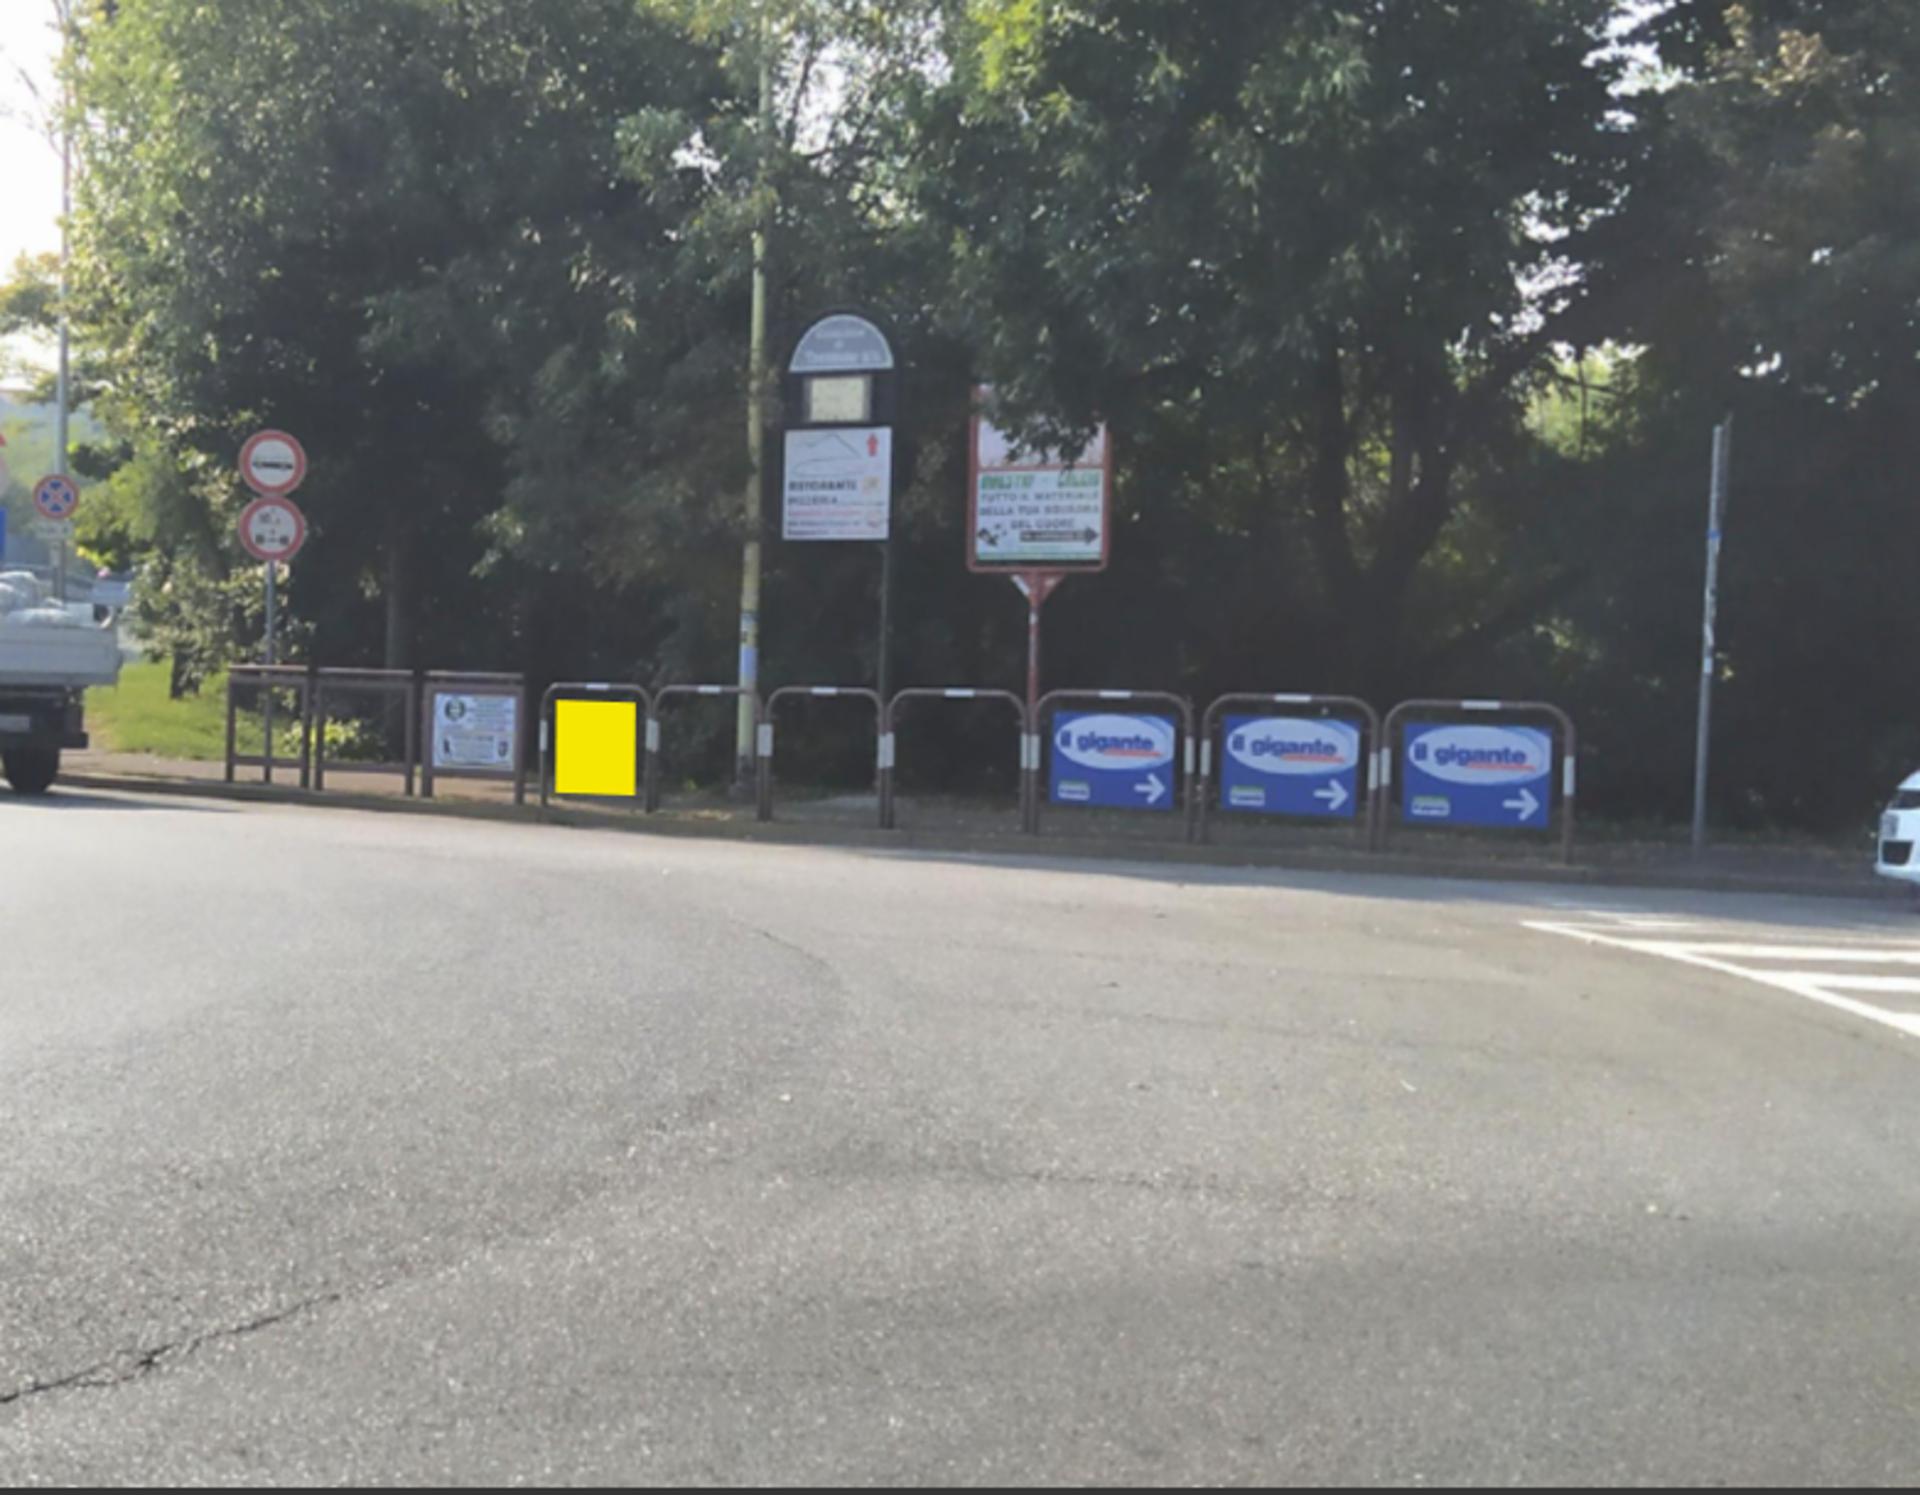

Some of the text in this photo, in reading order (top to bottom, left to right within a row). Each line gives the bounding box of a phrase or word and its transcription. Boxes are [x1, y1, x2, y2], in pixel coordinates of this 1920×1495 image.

[788, 480, 858, 492] RISTORANTE
[981, 493, 1017, 502] TUTTO
[1034, 491, 1099, 501] MATERIALE
[1077, 731, 1154, 753] gigante
[1251, 736, 1338, 757] gigante
[1434, 744, 1527, 766] gigante
